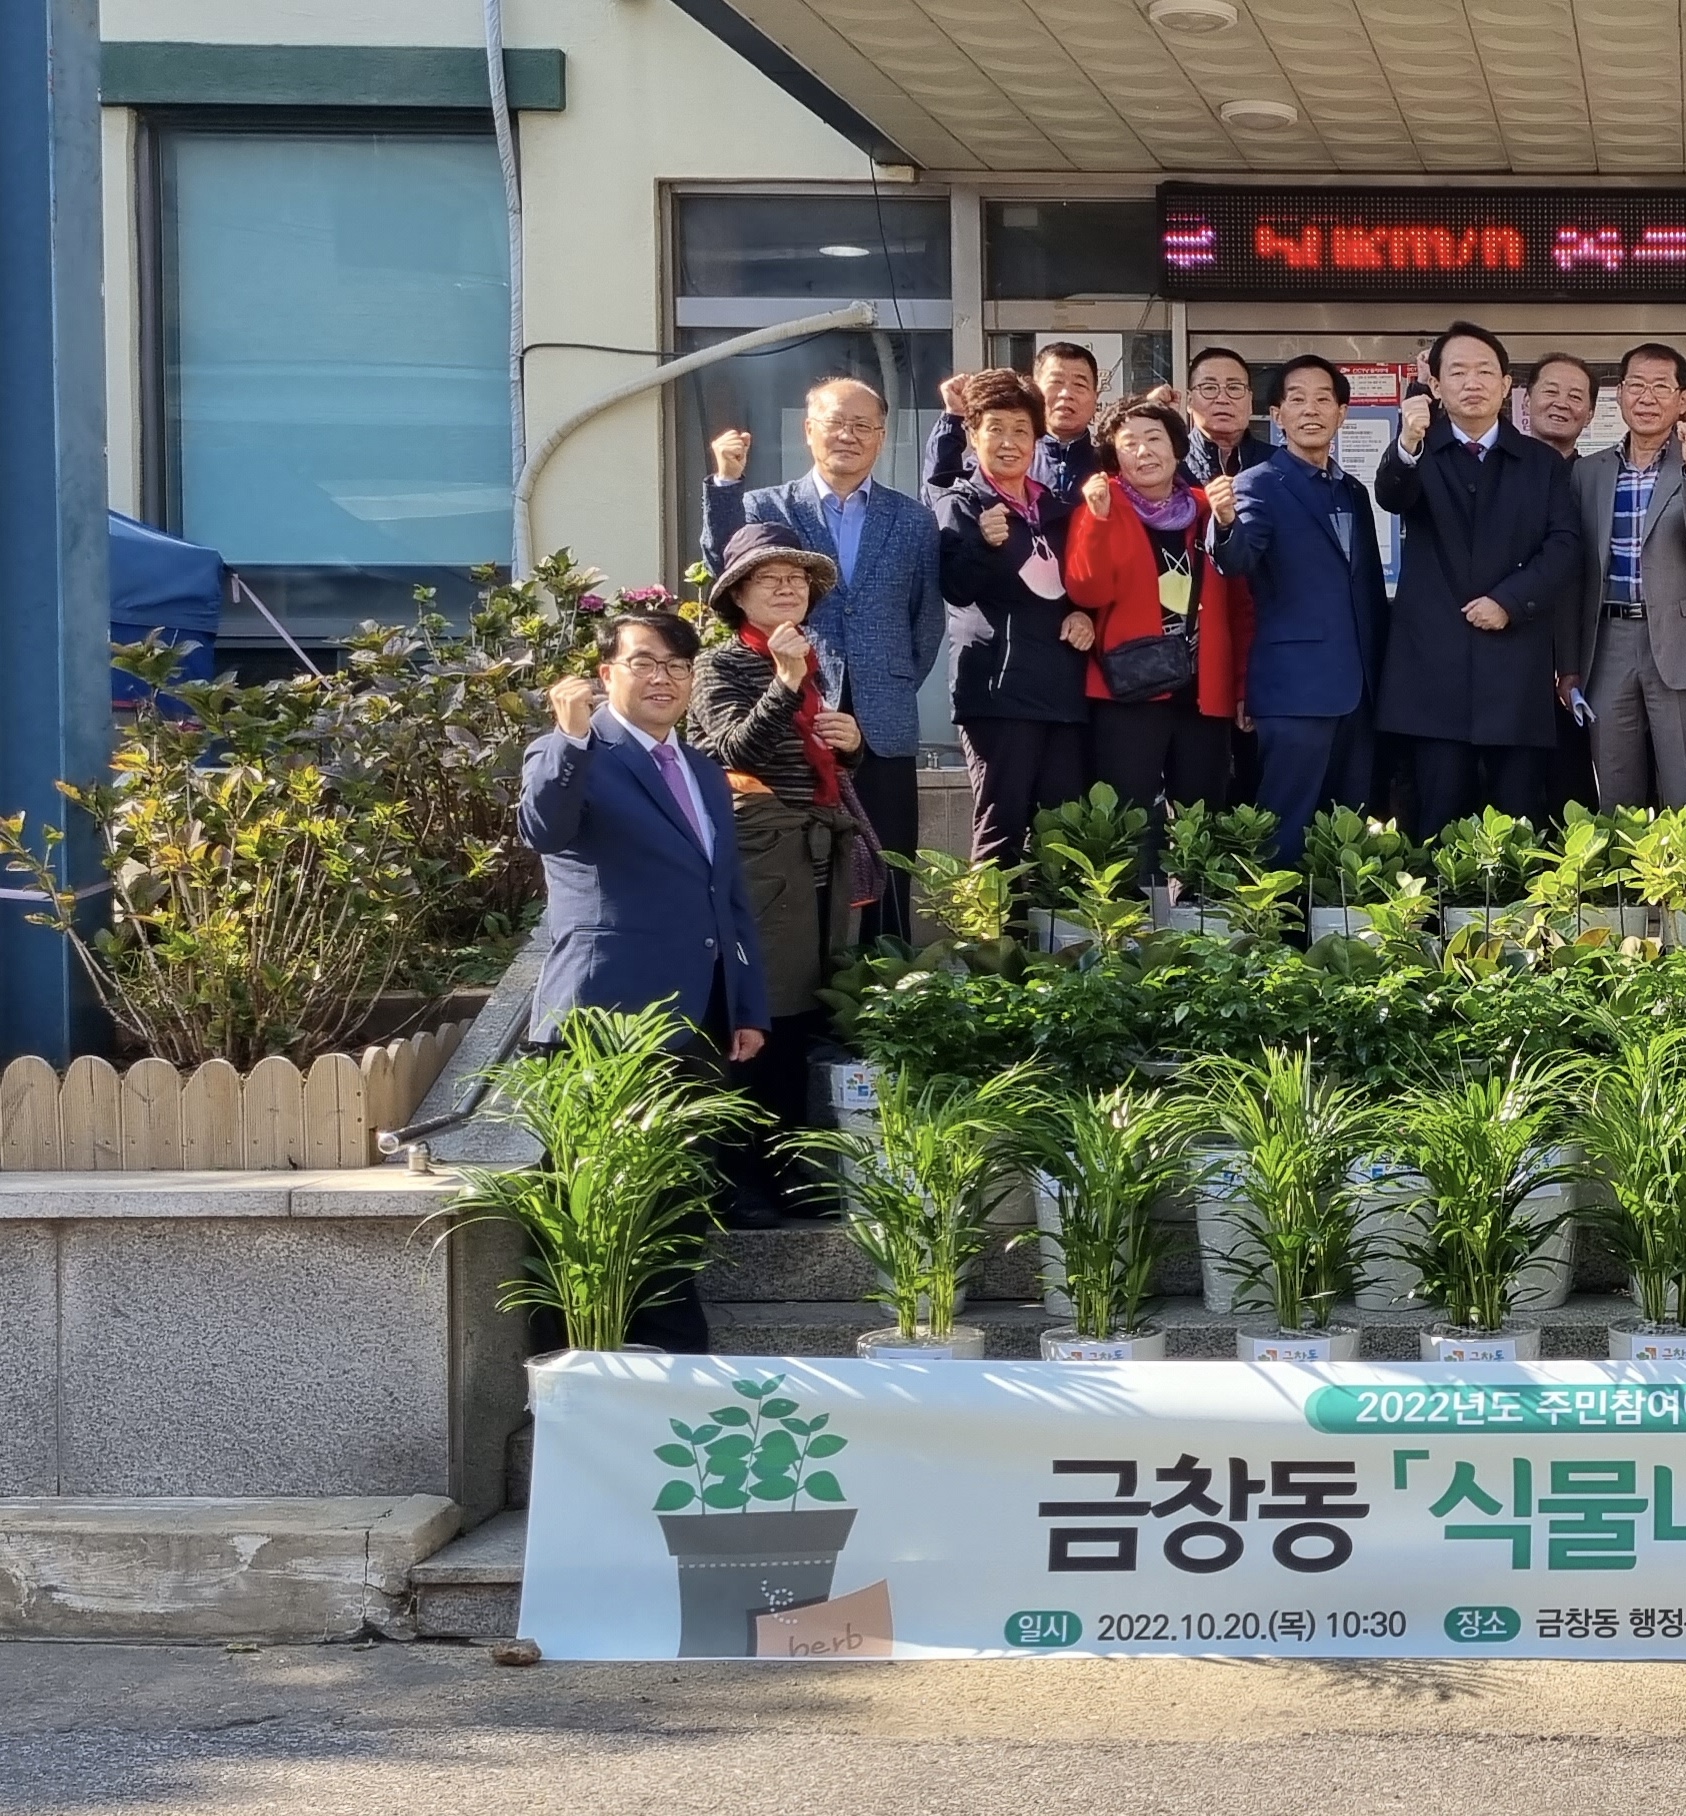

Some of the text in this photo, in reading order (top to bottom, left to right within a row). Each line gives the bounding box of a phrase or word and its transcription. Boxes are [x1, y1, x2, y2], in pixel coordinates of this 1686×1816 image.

[1356, 1390, 1524, 1426] 2022년도
[1038, 1452, 1370, 1574] 금창동
[1018, 1609, 1407, 1643] 일시 2022.10.20.(목) 10:30
[1456, 1609, 1508, 1638] 장소
[1535, 1607, 1620, 1639] 금창동
